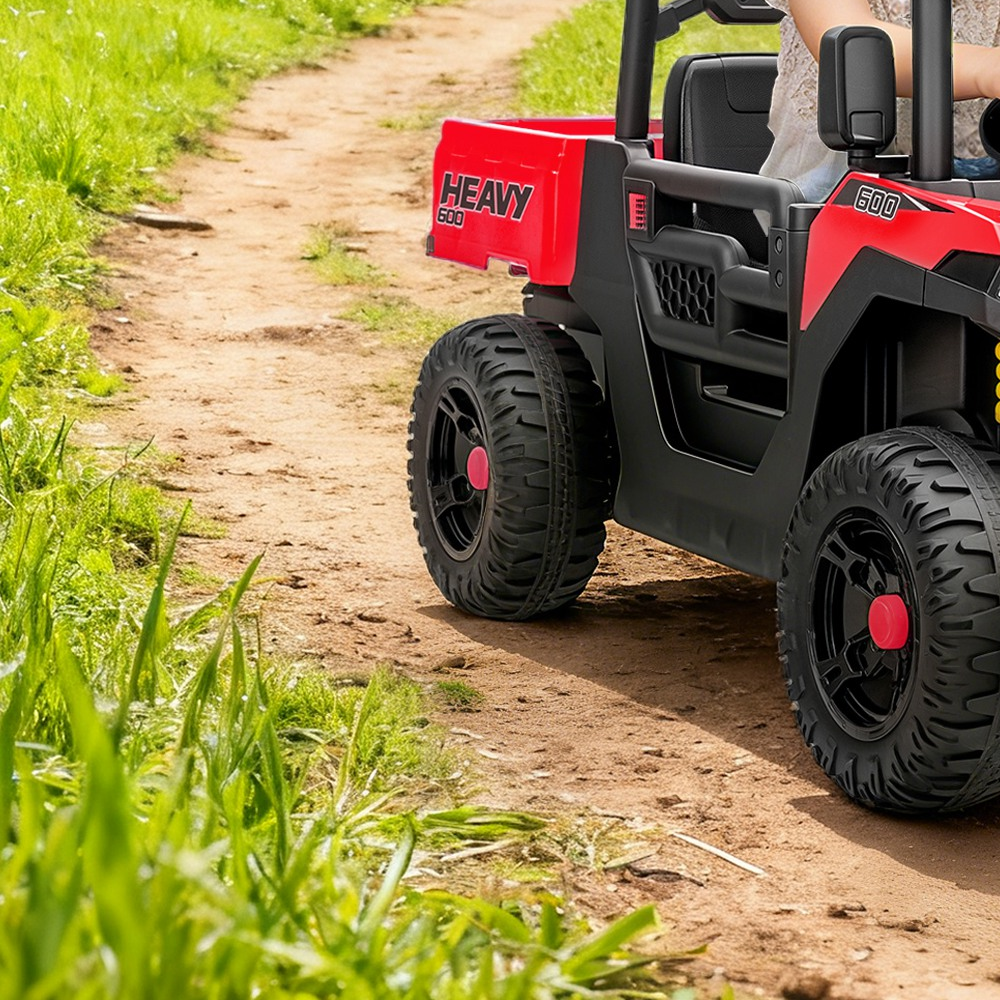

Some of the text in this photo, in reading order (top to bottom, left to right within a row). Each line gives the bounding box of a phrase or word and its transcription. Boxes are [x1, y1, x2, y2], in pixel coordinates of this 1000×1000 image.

[439, 172, 534, 221] HEAVY
[854, 185, 900, 221] 600
[437, 206, 464, 228] 600
